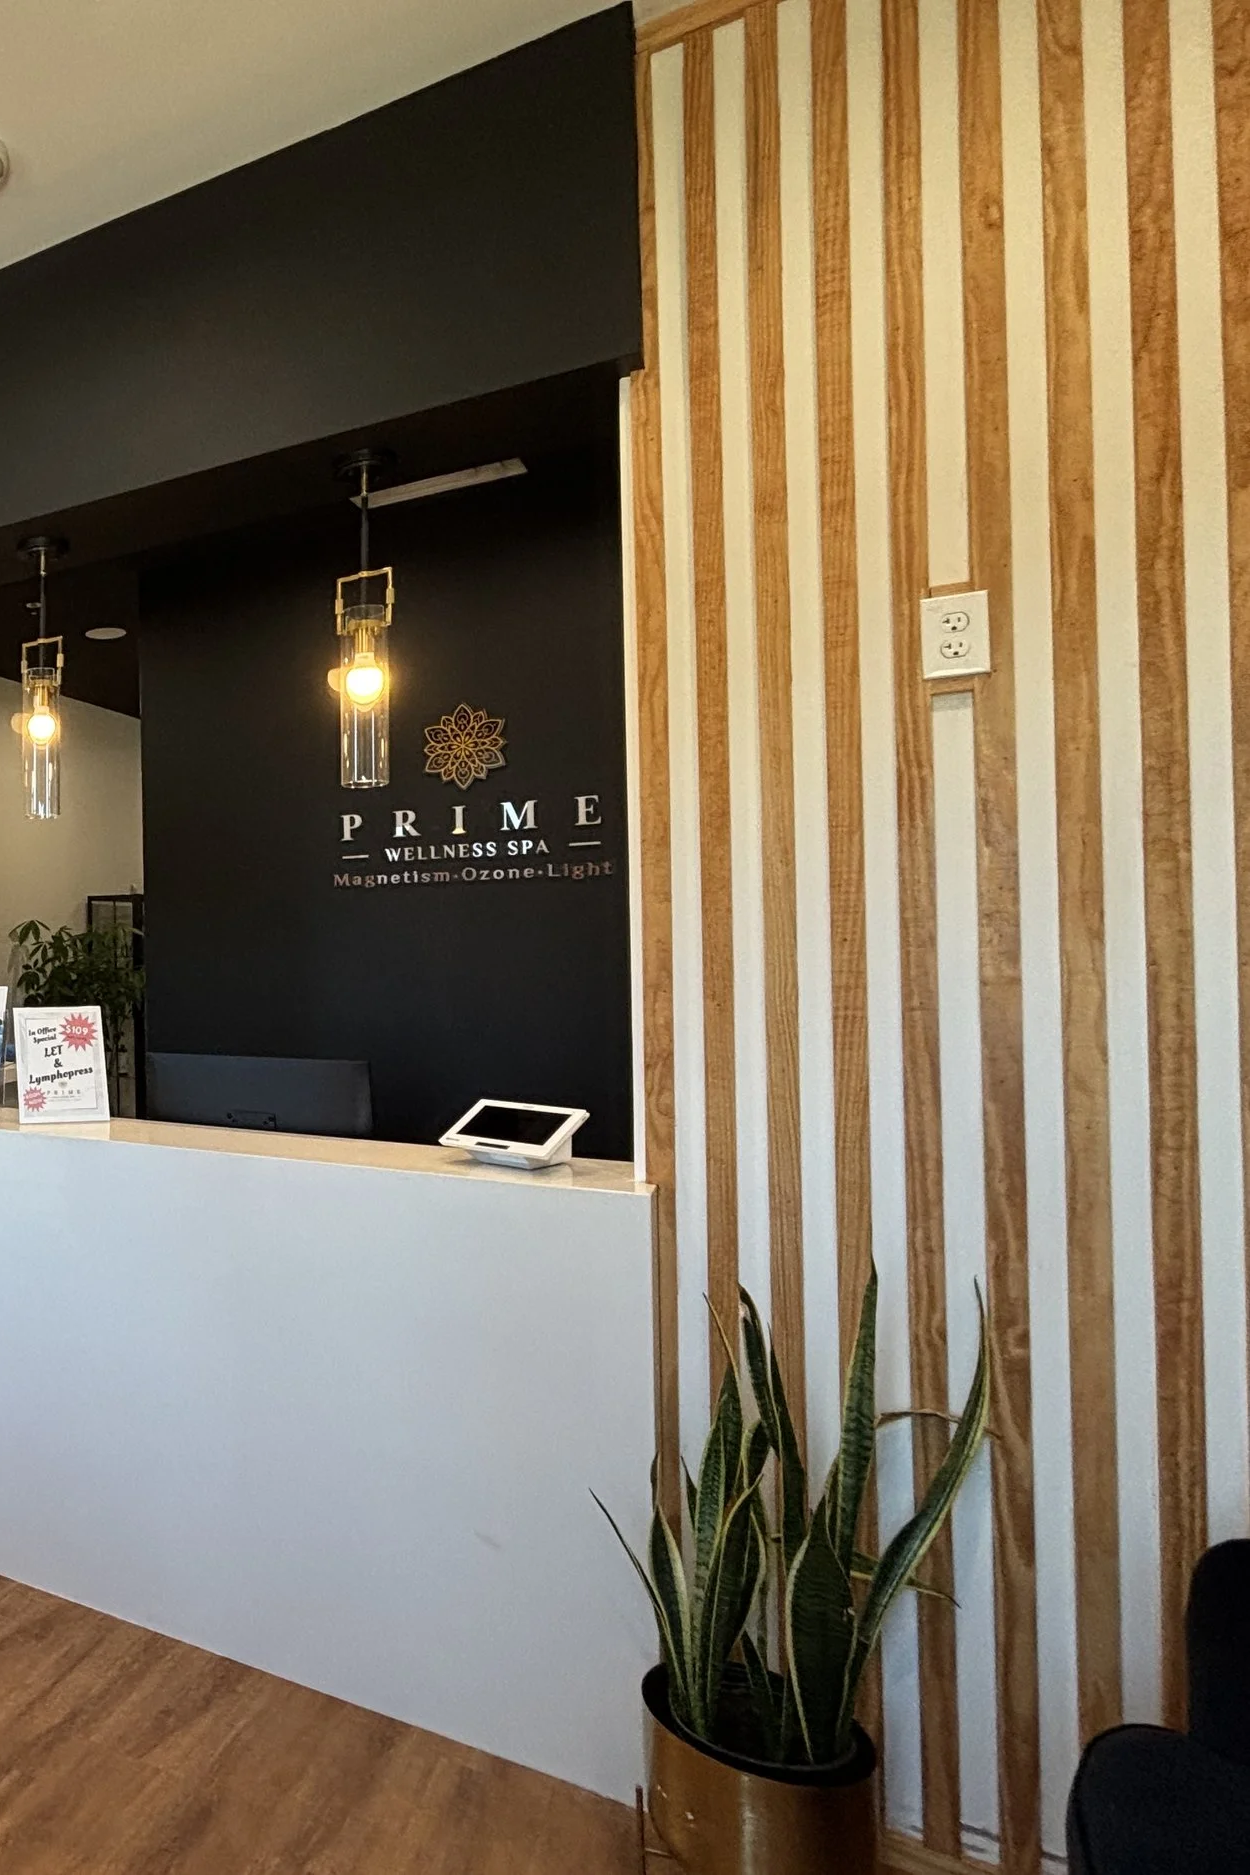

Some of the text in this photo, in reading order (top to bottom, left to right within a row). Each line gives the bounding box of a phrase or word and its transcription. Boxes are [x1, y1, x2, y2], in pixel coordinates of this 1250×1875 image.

[340, 795, 602, 842] PRIME
[384, 839, 550, 862] WELLNESS SPA
[37, 1027, 57, 1035] Office
[33, 1034, 57, 1044] Special
[44, 1045, 63, 1057] LET
[54, 1058, 63, 1068] &
